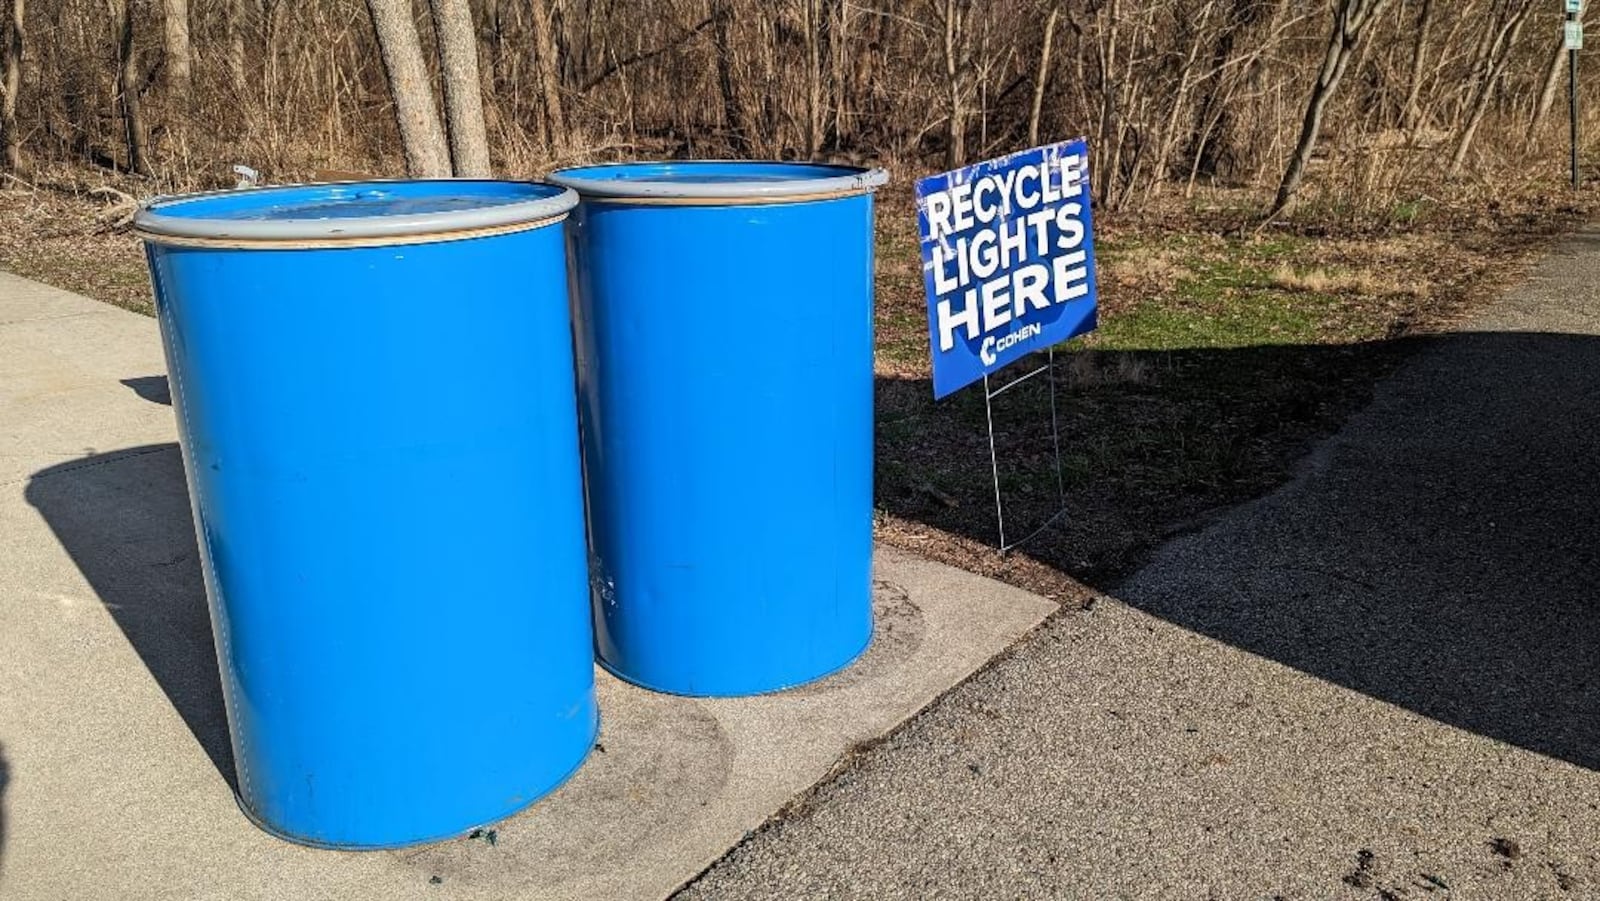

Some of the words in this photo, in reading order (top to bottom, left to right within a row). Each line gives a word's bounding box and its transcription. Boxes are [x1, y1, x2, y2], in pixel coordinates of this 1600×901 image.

[926, 154, 1082, 240] RECYCLE
[932, 203, 1084, 296] LIGHTS
[937, 250, 1089, 351] HERE
[996, 322, 1041, 352] COHEN
